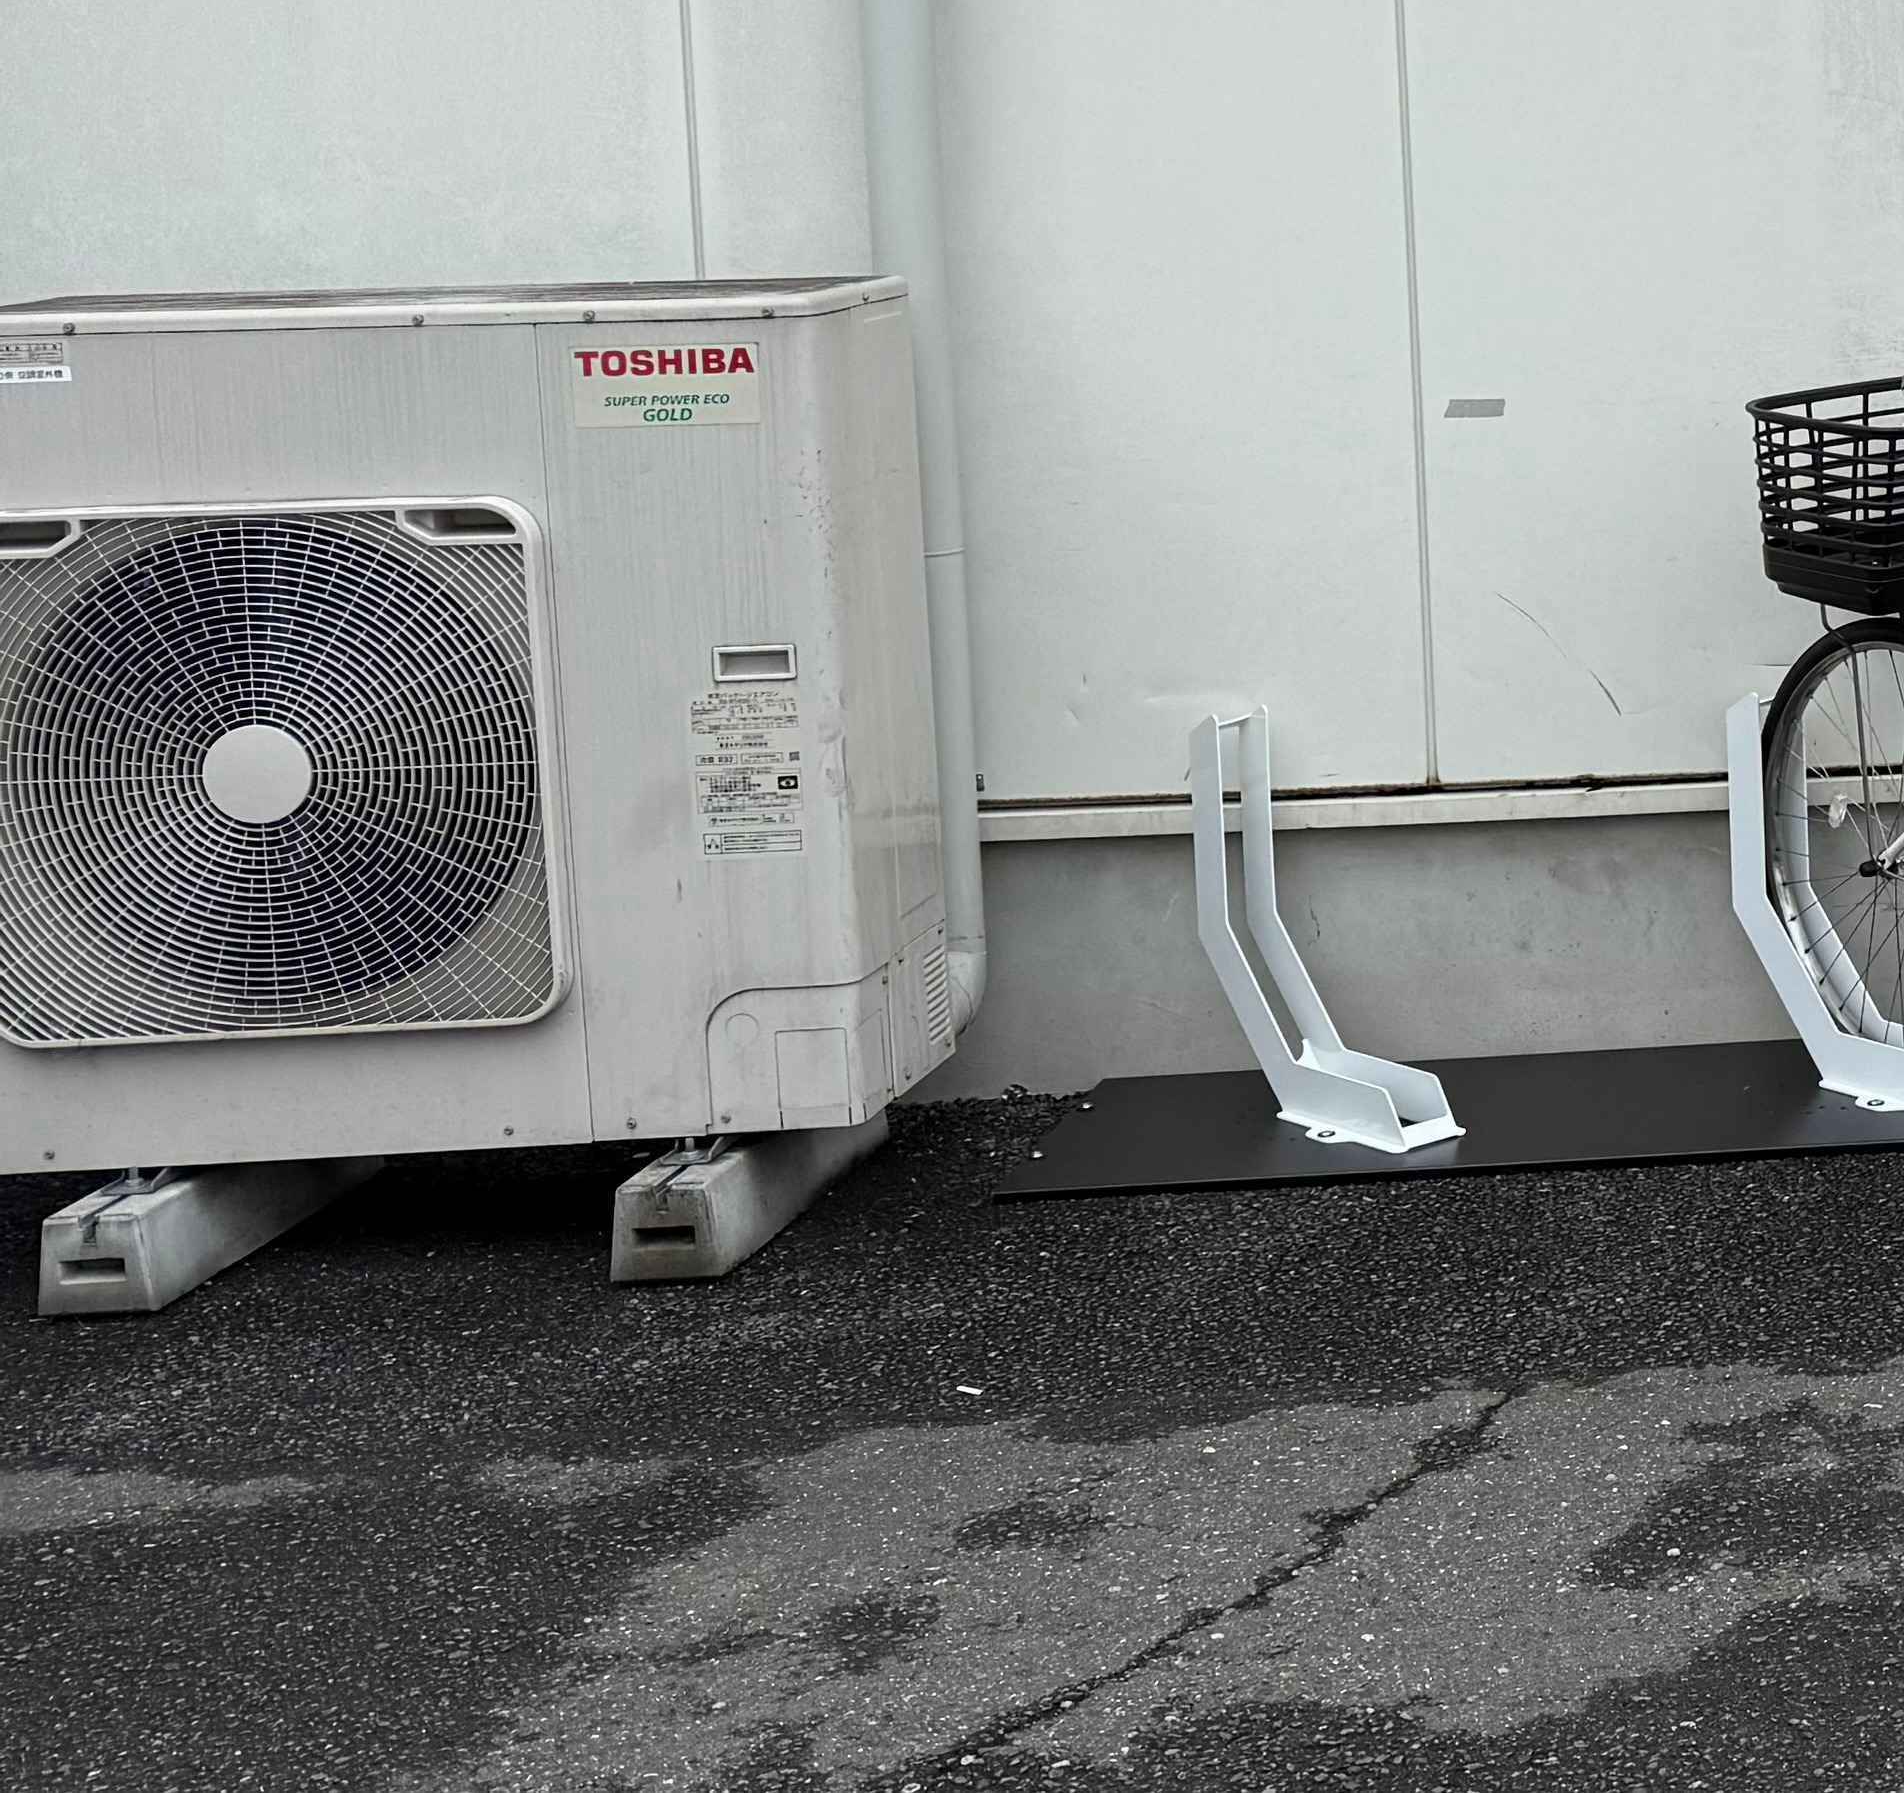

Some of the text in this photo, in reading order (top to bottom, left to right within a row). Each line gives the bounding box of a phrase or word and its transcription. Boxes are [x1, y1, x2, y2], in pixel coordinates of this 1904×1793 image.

[574, 347, 755, 377] TOSHIBA
[604, 393, 730, 407] SUPER POWER ECO
[643, 408, 693, 422] GOLD
